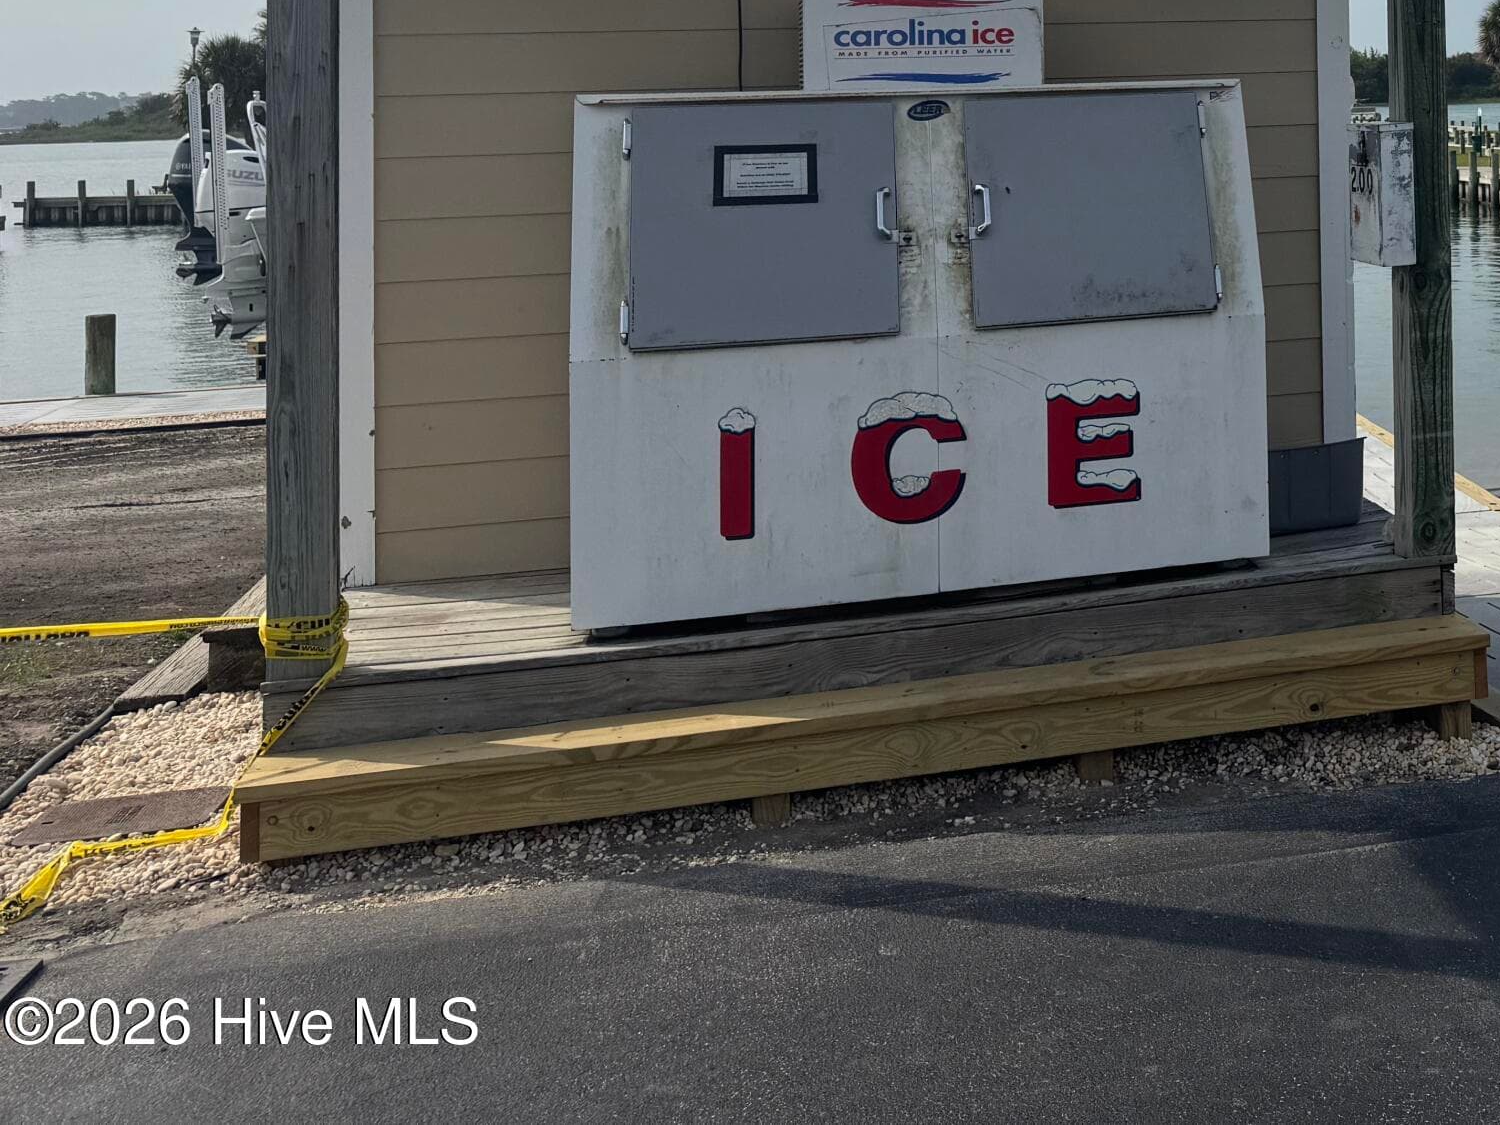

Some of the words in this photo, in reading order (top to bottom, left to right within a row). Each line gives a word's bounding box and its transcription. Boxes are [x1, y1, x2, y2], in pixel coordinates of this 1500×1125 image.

[833, 19, 966, 47] carolina
[971, 20, 1015, 45] ice
[911, 104, 945, 116] LEER
[717, 378, 1141, 540] ICE
